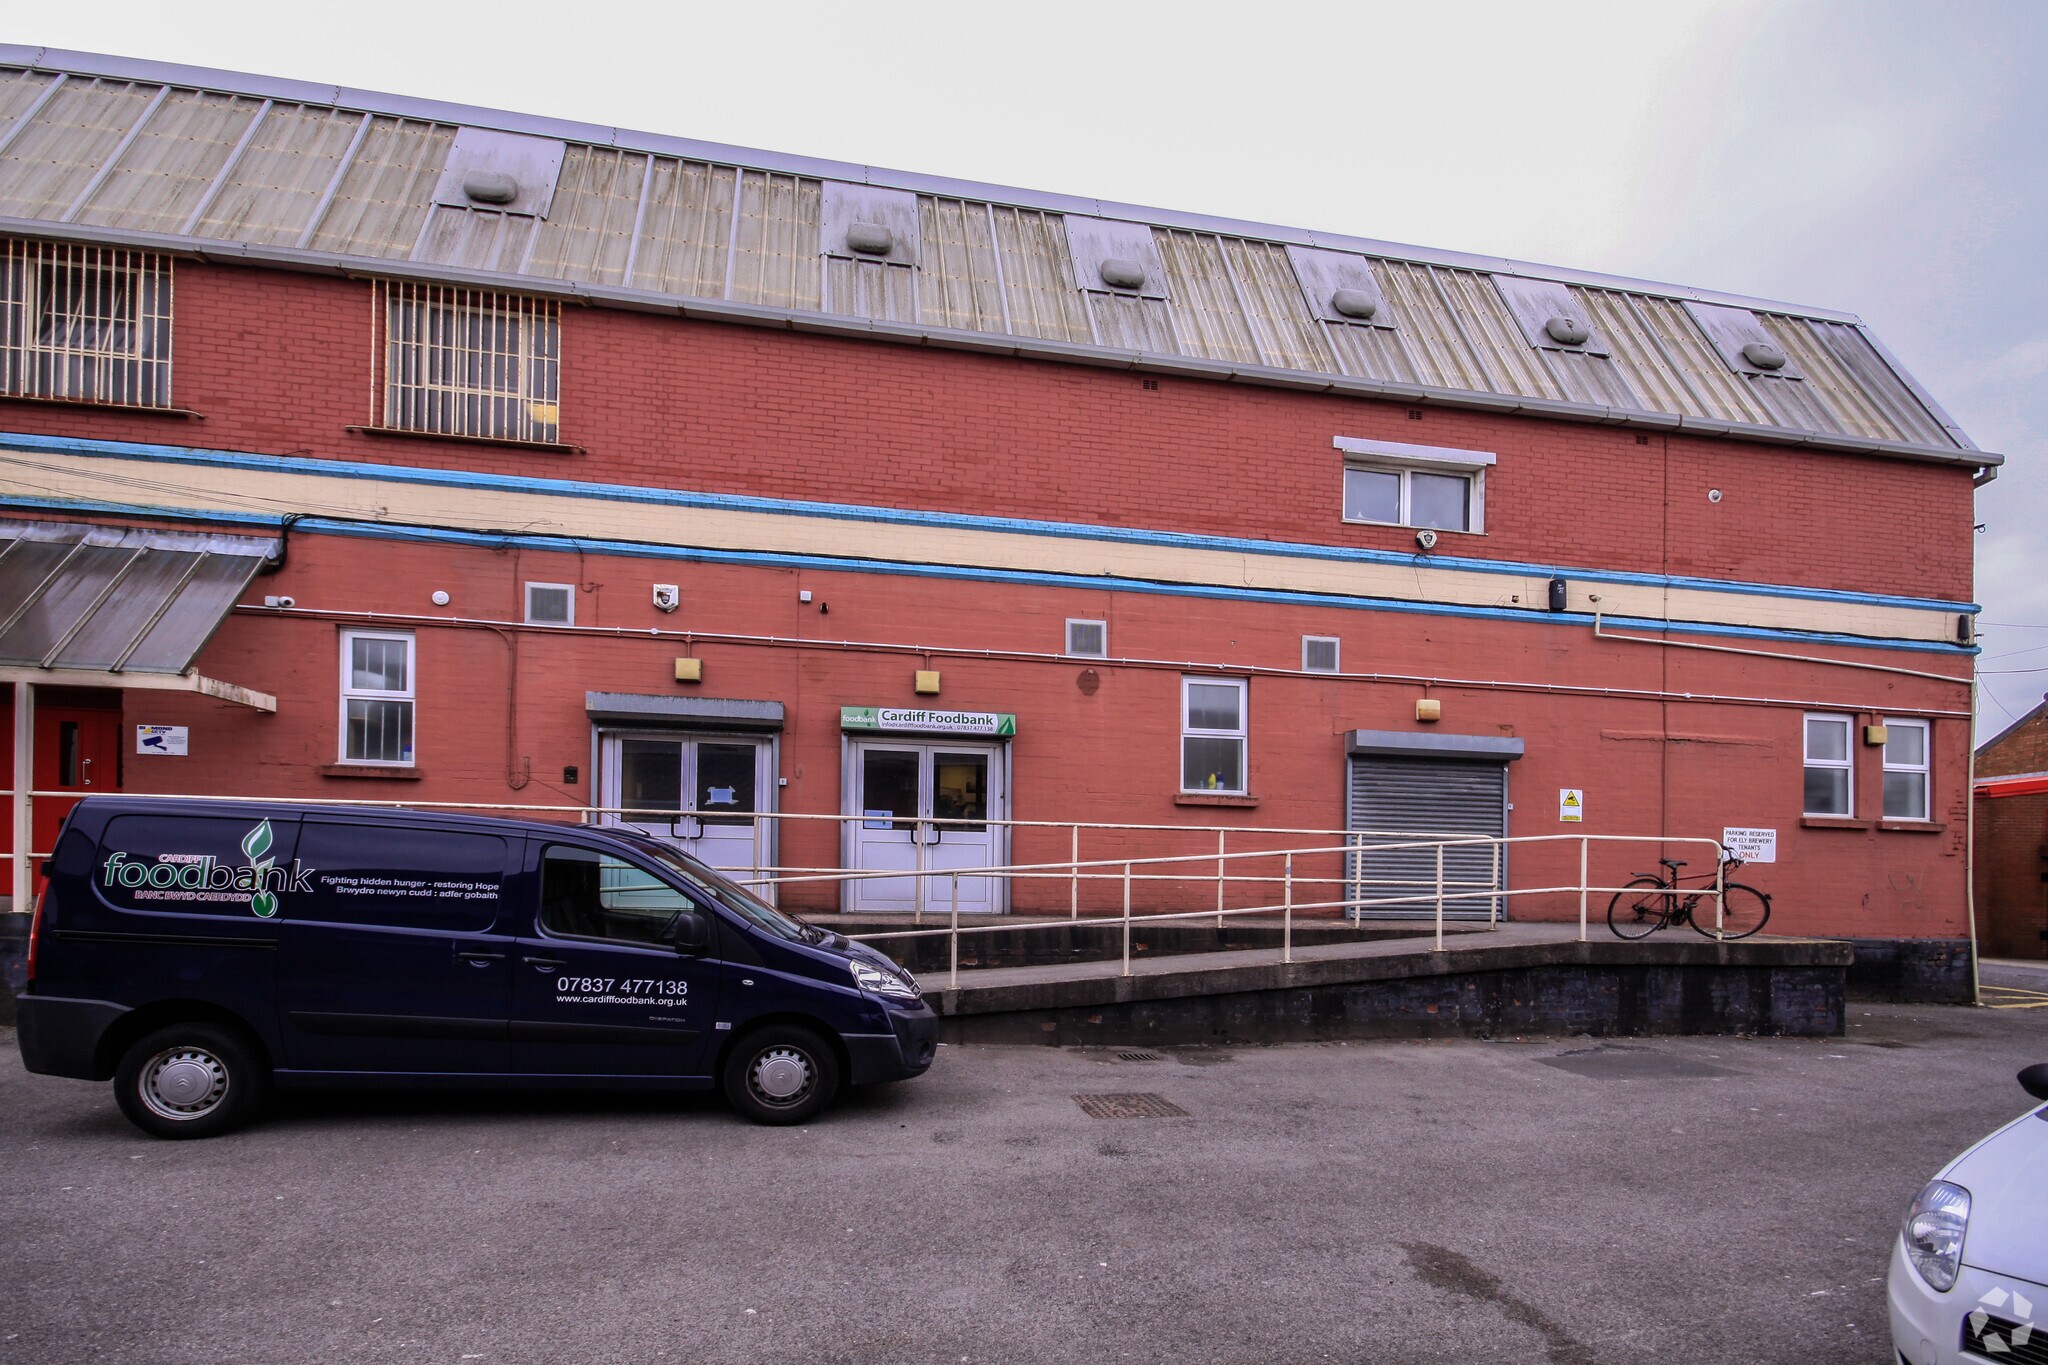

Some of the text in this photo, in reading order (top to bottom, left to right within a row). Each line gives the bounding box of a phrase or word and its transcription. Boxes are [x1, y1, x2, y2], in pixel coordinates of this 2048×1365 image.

[843, 714, 877, 723] foodbank
[882, 710, 993, 725] Cardiff Foodbank
[158, 853, 201, 864] CARDIFF
[104, 851, 316, 893] foodbank
[320, 875, 359, 886] Fighting
[360, 877, 392, 886] hidden
[393, 879, 426, 888] hunger
[433, 880, 473, 891] restoring
[475, 882, 500, 892] Hope
[134, 890, 253, 902] BANC BWYD CAERDYDD
[335, 885, 375, 896] Brwydro
[376, 888, 407, 897] newyn
[408, 889, 432, 897] cudd
[439, 890, 463, 898] adfer
[464, 890, 498, 900] gobaith
[556, 976, 688, 995] 07837 477138
[556, 994, 688, 1007] www.cardifffoodbank.org.uk
